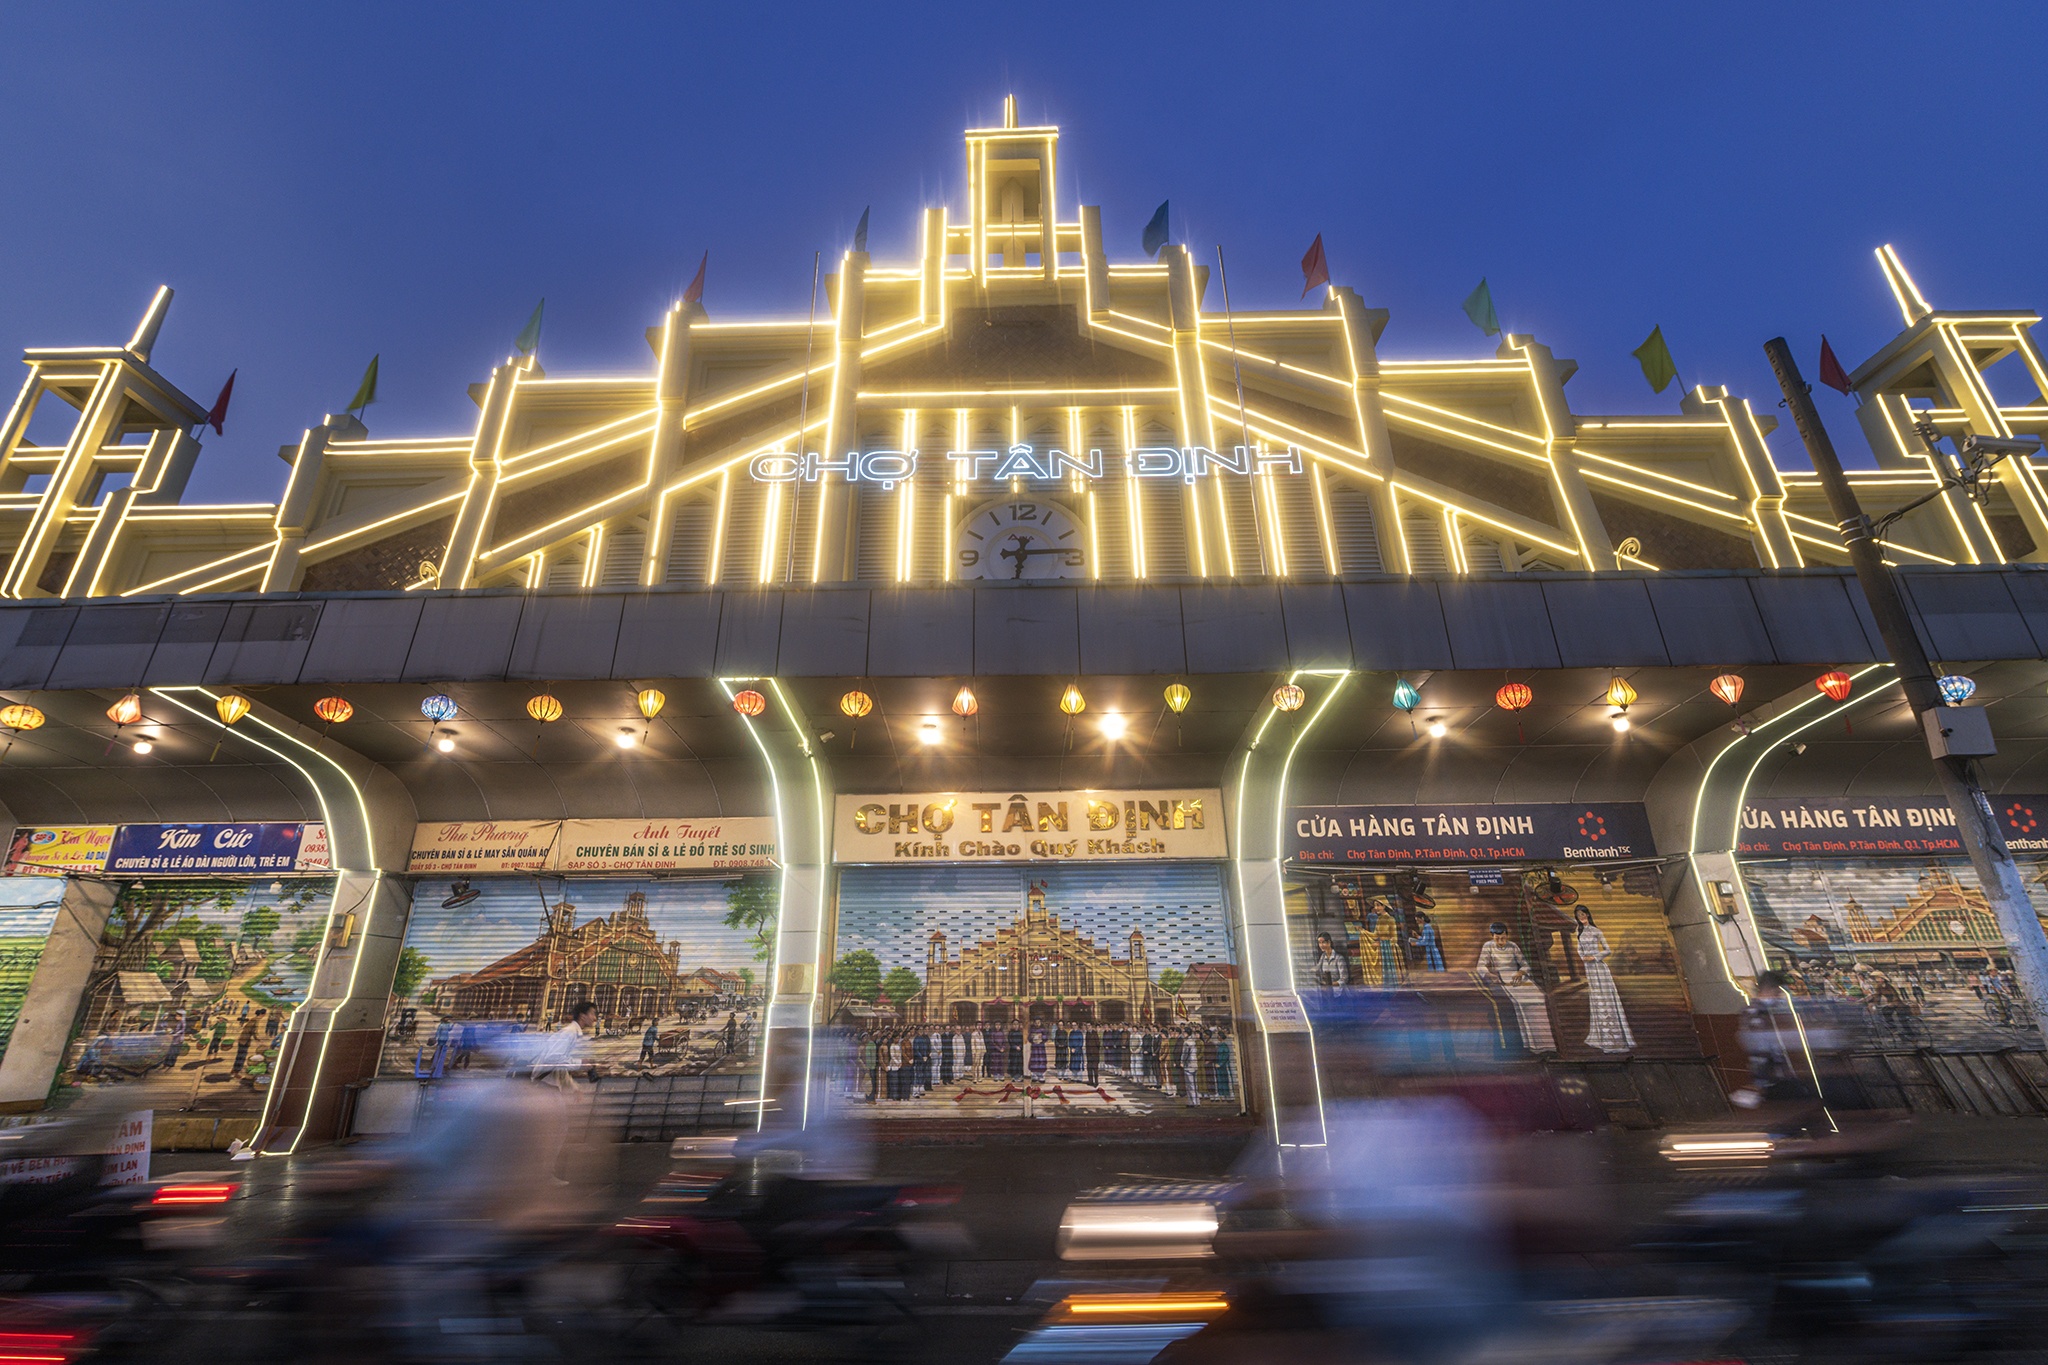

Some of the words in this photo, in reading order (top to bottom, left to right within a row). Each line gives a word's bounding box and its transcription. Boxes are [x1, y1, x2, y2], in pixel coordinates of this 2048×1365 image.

[749, 449, 918, 490] CHỢ
[947, 443, 1102, 480] TÂN
[1127, 444, 1303, 485] ĐỊNH
[1008, 504, 1037, 521] 12
[958, 550, 979, 567] 9
[1064, 549, 1085, 567] 3
[854, 801, 956, 841] CHỢ
[971, 793, 1068, 834] TÂN
[1086, 798, 1206, 840] ĐỊNH
[1740, 806, 1776, 829] ỬA
[1780, 806, 1849, 829] HÀNG
[1853, 805, 1902, 828] TÂN
[633, 822, 670, 840] Ánh
[676, 824, 723, 842] Tuyết
[1296, 813, 1344, 838] CỬA
[1349, 811, 1415, 838] HÀNG
[1422, 812, 1470, 838] TÂN
[1475, 815, 1535, 841] ĐỊNH
[157, 828, 202, 849] Kim
[213, 827, 254, 849] Cúc
[437, 822, 468, 843] Thu
[471, 822, 530, 848] Phương
[576, 843, 620, 858] CHUYÊN
[622, 843, 647, 857] BÁN
[648, 842, 660, 857] SỈ
[661, 845, 670, 857] &
[673, 842, 686, 857] LẺ
[708, 841, 728, 856] TRẺ
[731, 843, 747, 856] SƠ
[749, 844, 775, 855] SINH
[894, 839, 950, 858] Kính
[957, 837, 1021, 857] Chào
[1029, 838, 1078, 860] Quý
[1086, 836, 1167, 856] Khách
[1782, 840, 1801, 853] Chợ
[1802, 840, 1820, 852] Tân
[1822, 840, 1849, 853] Định,
[1850, 839, 1875, 851] P.Tân
[1876, 839, 1903, 852] Định,
[1921, 839, 1960, 852] Tp.HCM
[2004, 838, 2048, 850] enthanh
[115, 854, 150, 869] CHUYÊN
[151, 854, 161, 868] SỈ
[161, 857, 169, 868] &
[170, 853, 181, 868] LẺ
[181, 854, 195, 868] ÁO
[195, 854, 210, 868] DÀI
[210, 854, 237, 867] NGƯỜI
[258, 853, 276, 868] TRẺ
[276, 856, 291, 867] EM
[411, 847, 440, 860] CHUYÊN
[441, 847, 456, 859] BÁN
[466, 850, 473, 859] &
[484, 850, 501, 859] MAY
[1299, 849, 1317, 862] Địa
[1346, 848, 1367, 861] Chợ
[1368, 847, 1386, 860] Tân
[1387, 848, 1413, 861] Định,
[1415, 847, 1442, 860] P.Tân
[1442, 848, 1468, 861] Định,
[1488, 847, 1526, 860] Tp.HCM
[614, 861, 634, 870] CHỢ
[635, 859, 653, 868] TÂN
[654, 860, 676, 869] ĐỊNH
[713, 860, 727, 868] ĐT:
[120, 1159, 138, 1174] LAN
